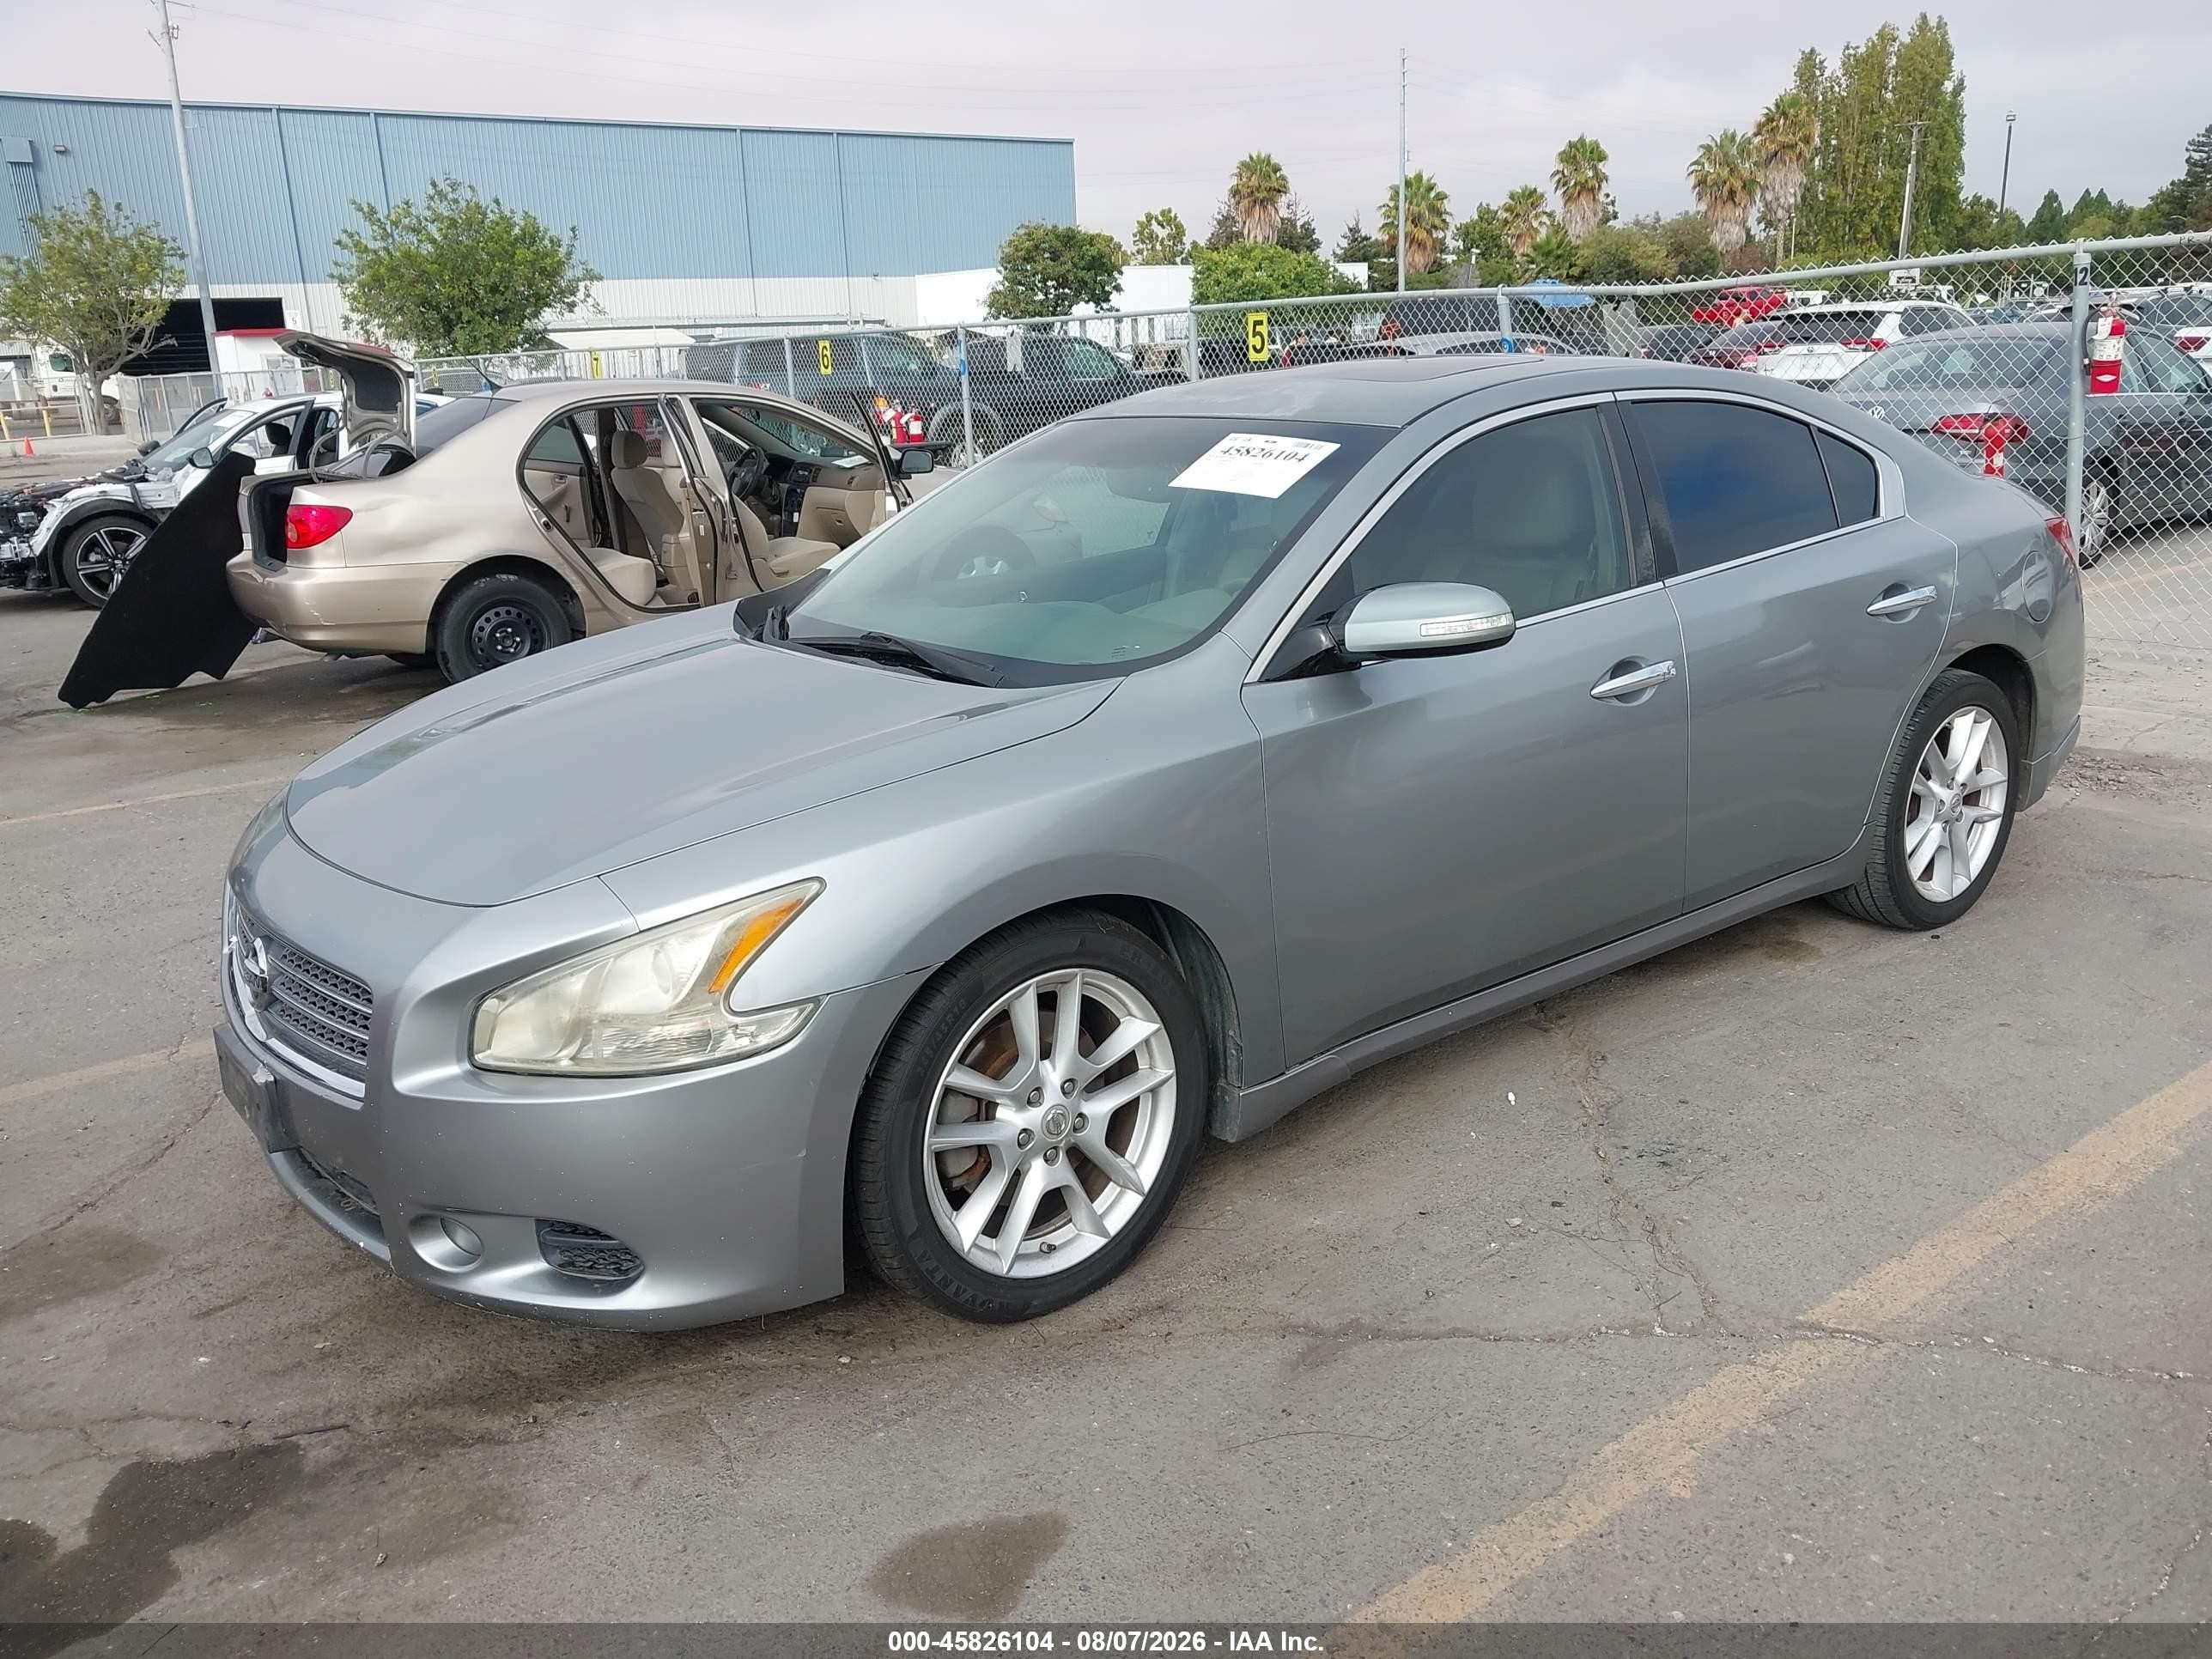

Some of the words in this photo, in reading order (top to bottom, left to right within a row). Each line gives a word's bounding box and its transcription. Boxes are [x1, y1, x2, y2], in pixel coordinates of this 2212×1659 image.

[2075, 266, 2088, 287] 12
[1252, 319, 1265, 354] 5
[592, 356, 599, 377] 7
[822, 345, 830, 369] 6
[1220, 446, 1310, 463] 45826104
